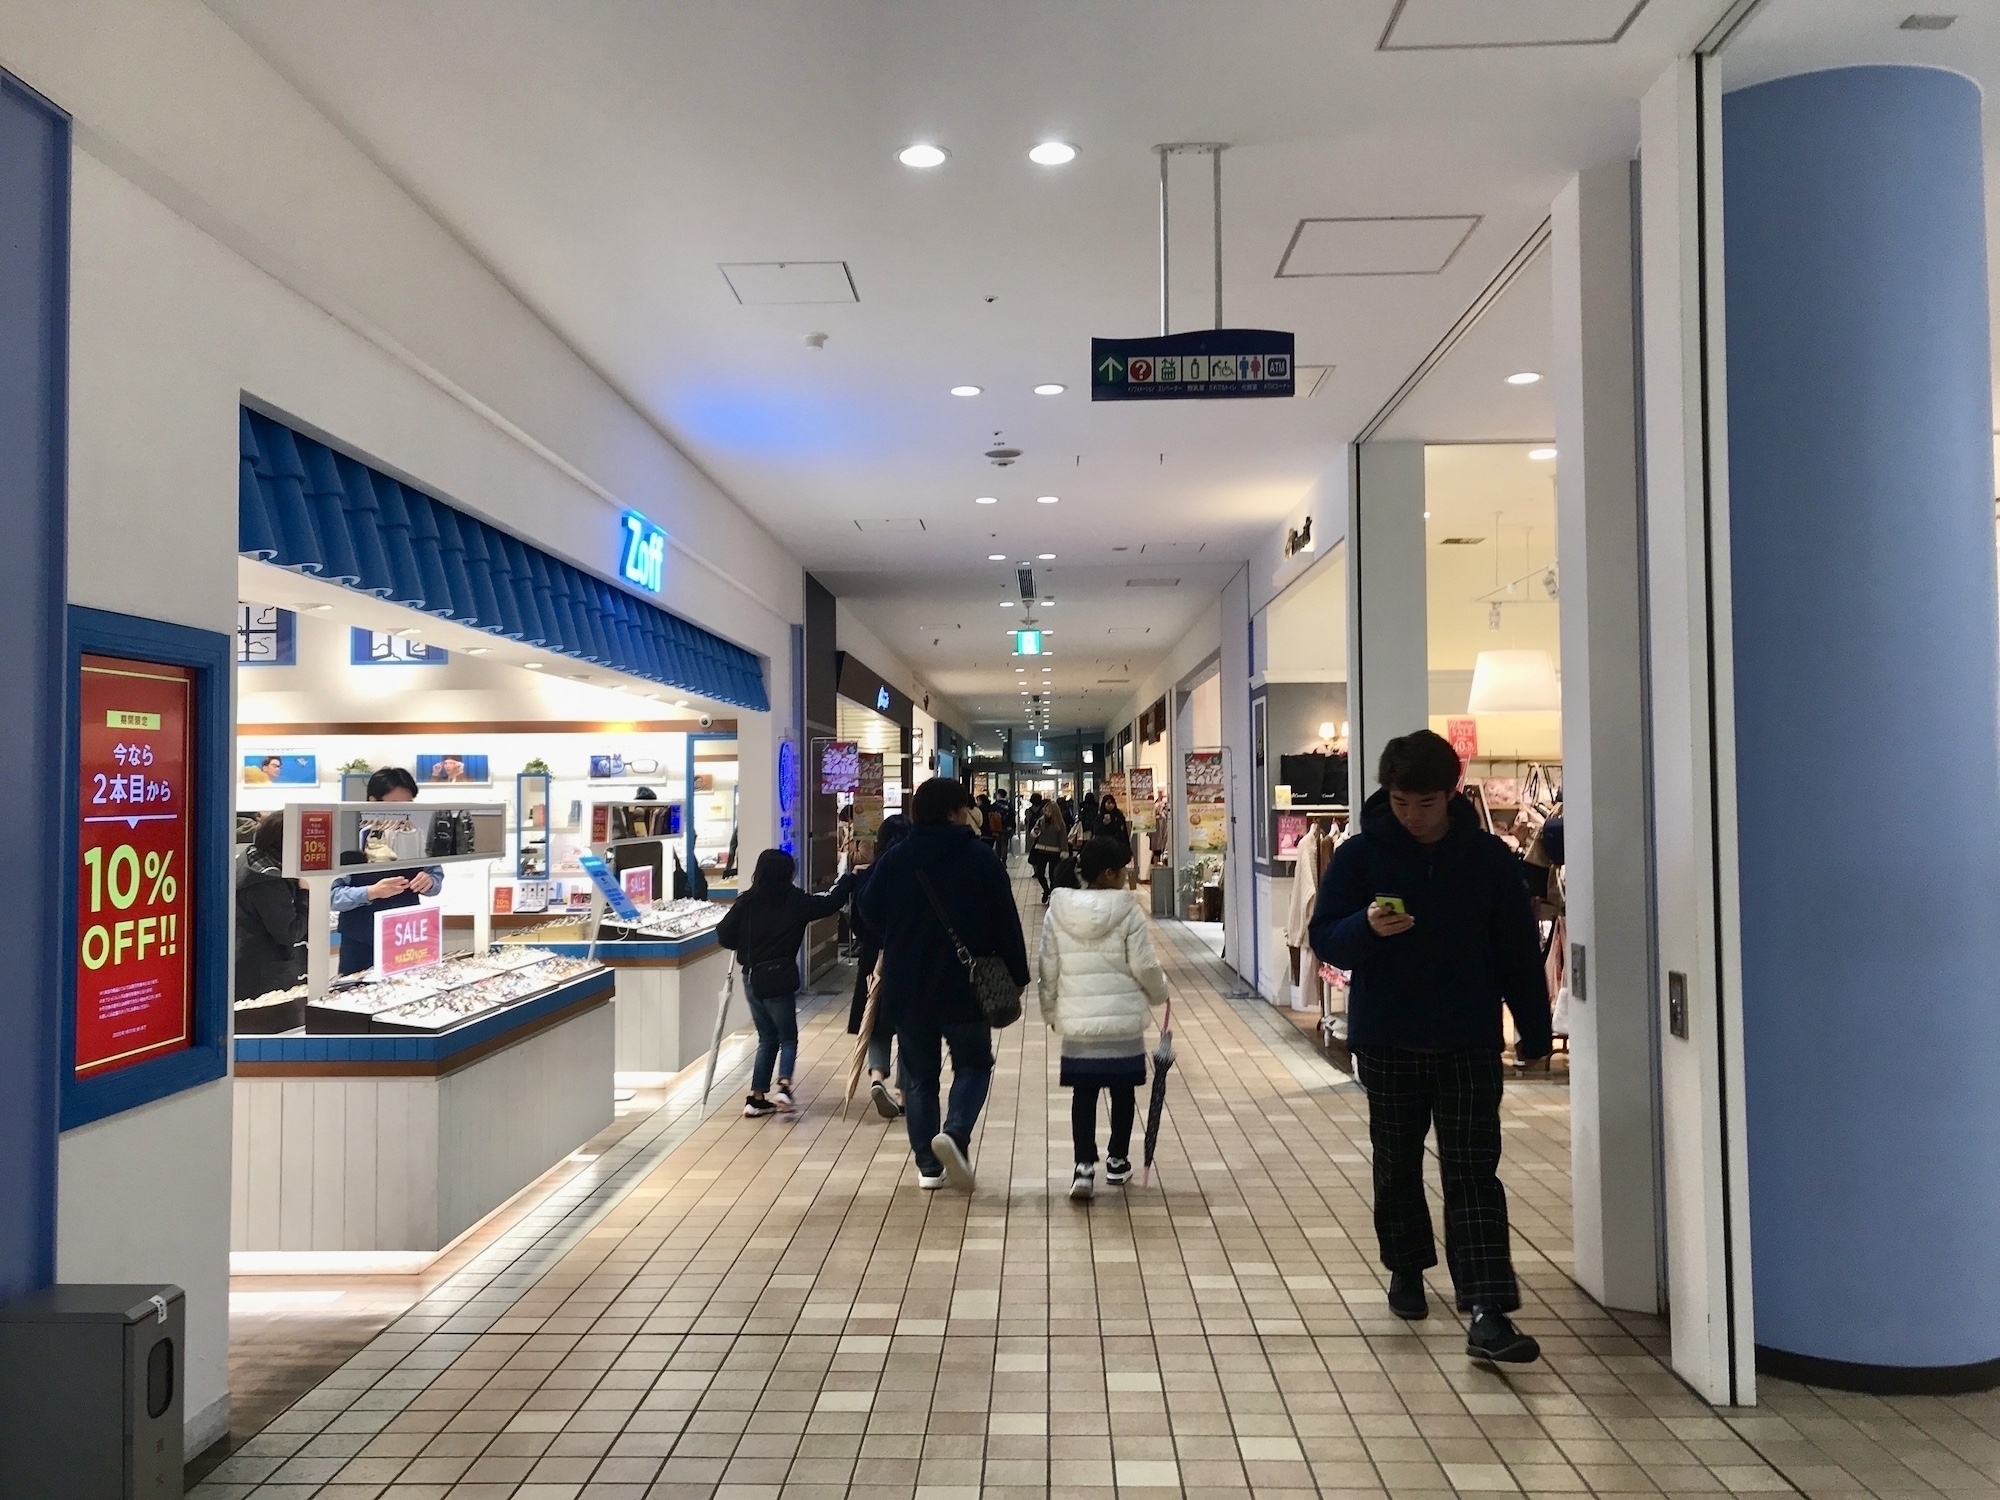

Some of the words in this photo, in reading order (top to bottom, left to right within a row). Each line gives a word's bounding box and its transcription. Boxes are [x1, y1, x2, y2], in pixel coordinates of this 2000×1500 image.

[1269, 360, 1287, 374] ATM
[622, 514, 664, 593] Zoff
[113, 742, 154, 767] 今なら
[92, 773, 172, 804] 2本目から
[304, 840, 326, 853] 10%
[83, 844, 177, 913] 10%
[630, 875, 646, 893] SALE
[81, 914, 177, 970] OFF!!
[394, 918, 429, 947] SALE
